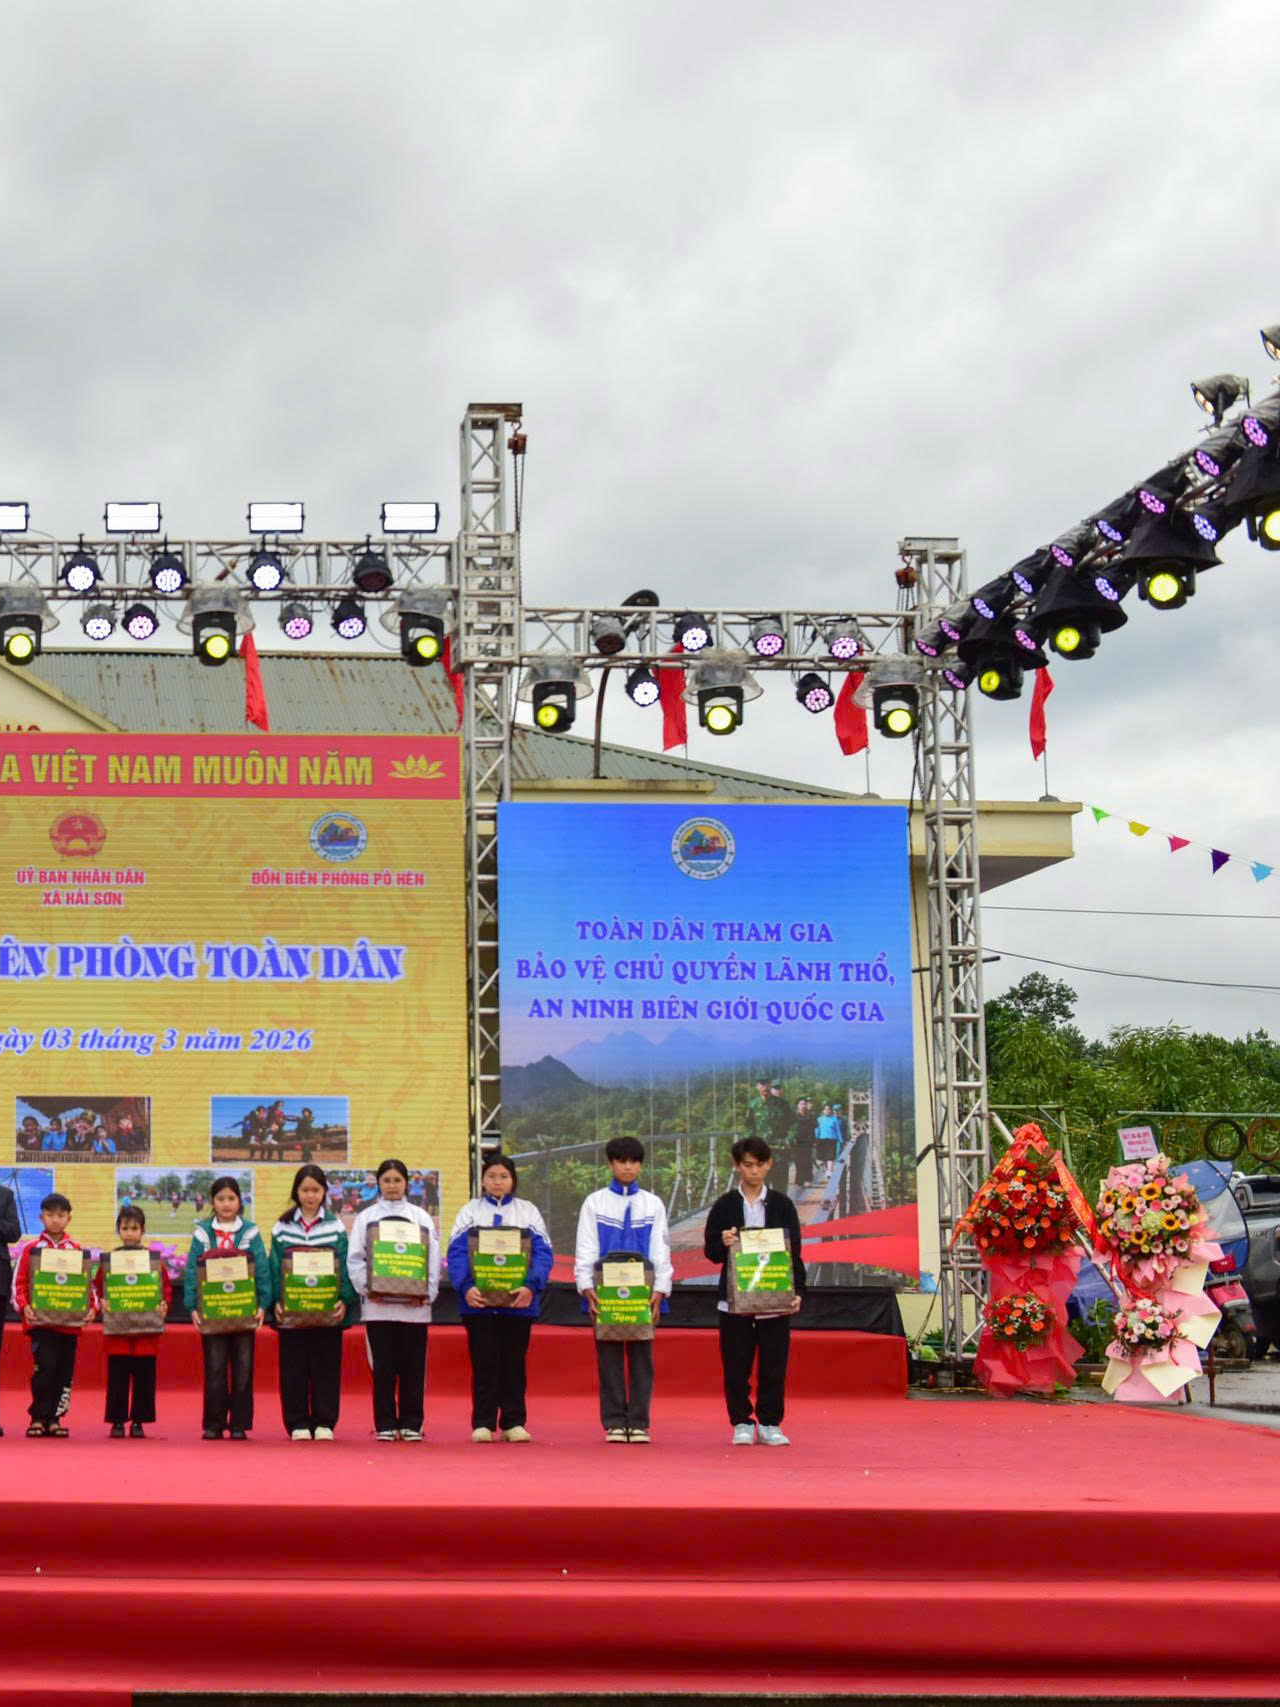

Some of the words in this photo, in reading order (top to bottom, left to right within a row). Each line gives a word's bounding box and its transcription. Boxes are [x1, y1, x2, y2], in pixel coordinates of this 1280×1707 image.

[31, 748, 97, 790] VIỆT
[107, 754, 181, 784] NAM
[192, 750, 288, 786] MUÔN
[299, 751, 372, 786] NĂM
[39, 871, 67, 884] BAN
[72, 868, 111, 884] NHÂN
[116, 868, 144, 884] DÂN
[94, 891, 122, 904] SƠN
[576, 916, 643, 940] TOÀN
[652, 916, 704, 941] DÂN
[712, 922, 782, 942] THAM
[790, 923, 833, 942] GIA
[57, 938, 195, 977] PHÒNG
[206, 939, 311, 979] TOÀN
[322, 941, 403, 979] DÂN
[516, 951, 566, 978] BẢO
[575, 954, 606, 985] VỆ
[614, 953, 664, 979] CHỦ
[672, 952, 756, 984] QUYỀN
[765, 956, 831, 981] LÃNH
[839, 952, 895, 986] THỔ,
[528, 999, 563, 1018] AN
[572, 999, 633, 1019] NINH
[641, 994, 698, 1019] BIÊN
[706, 995, 758, 1020] GIỚI
[766, 992, 833, 1025] QUỐC
[841, 1002, 885, 1021] GIA
[42, 1028, 72, 1049] 03
[79, 1028, 154, 1055] tháng
[161, 1029, 177, 1049] 3
[184, 1030, 241, 1050] năm
[250, 1029, 312, 1050] 2026
